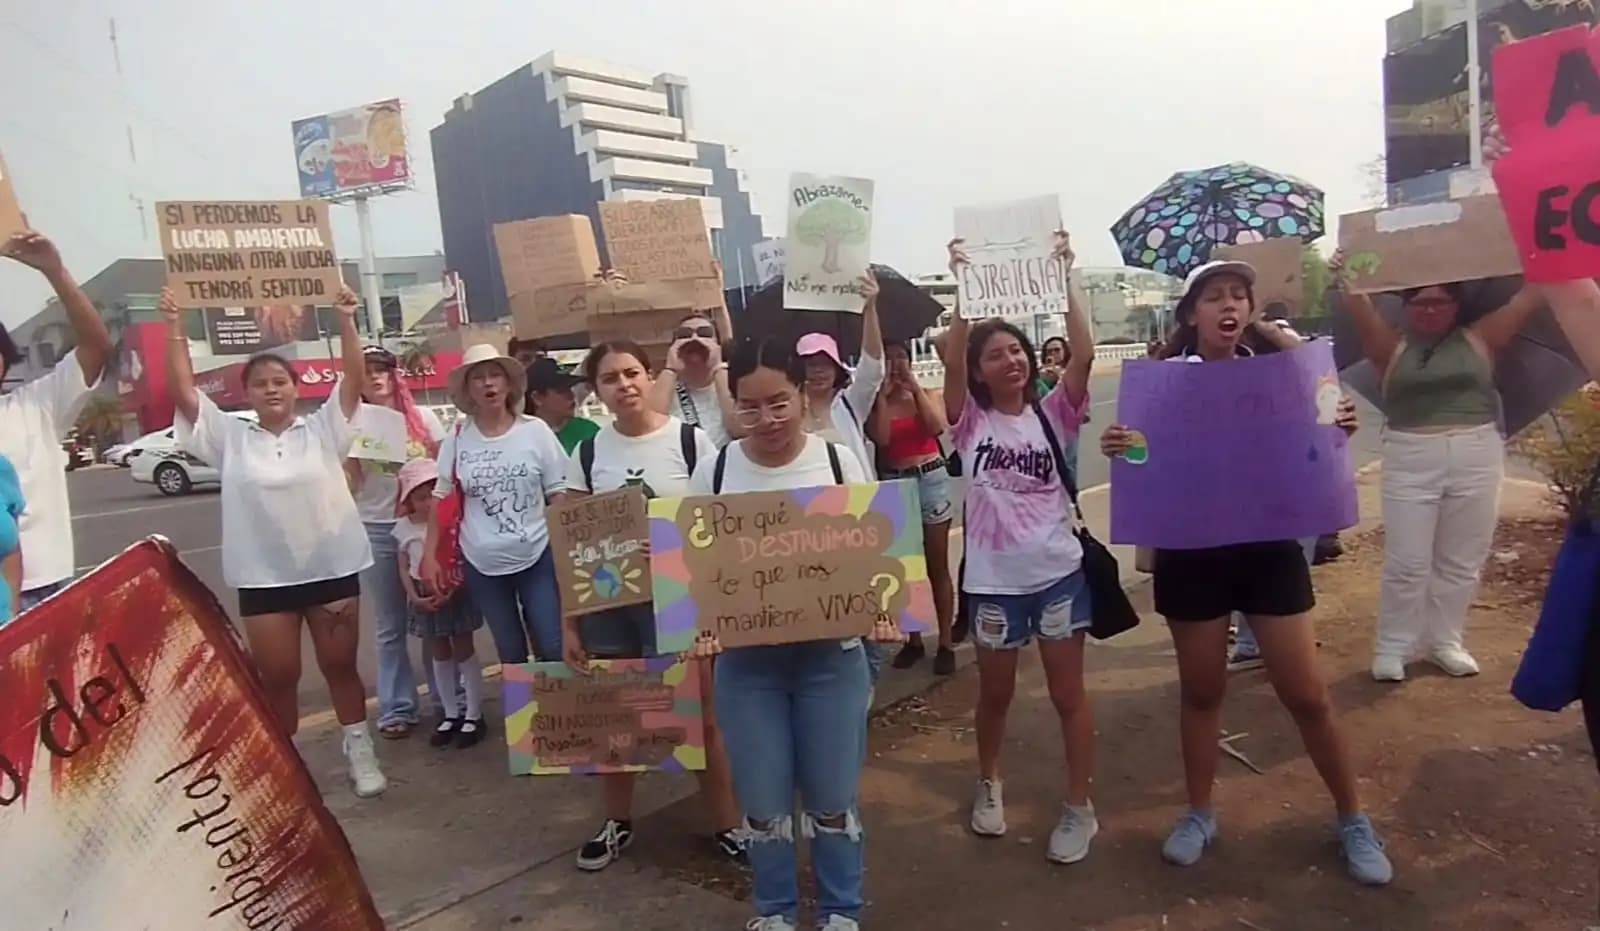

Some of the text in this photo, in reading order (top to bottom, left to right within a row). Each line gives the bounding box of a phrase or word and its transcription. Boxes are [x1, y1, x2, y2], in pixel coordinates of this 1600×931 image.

[166, 204, 316, 225] SI PERDEMOS LA
[171, 227, 324, 249] LUCHA AMBIENTAL
[168, 249, 336, 272] NINGUNA OTRA LUCHA
[185, 276, 324, 299] TENDRÁ SENTIDO
[973, 437, 1053, 485] THRASHER
[754, 502, 791, 535] qué
[752, 567, 787, 600] que
[799, 562, 841, 578] nos
[716, 603, 807, 634] mantiene
[39, 642, 146, 758] del
